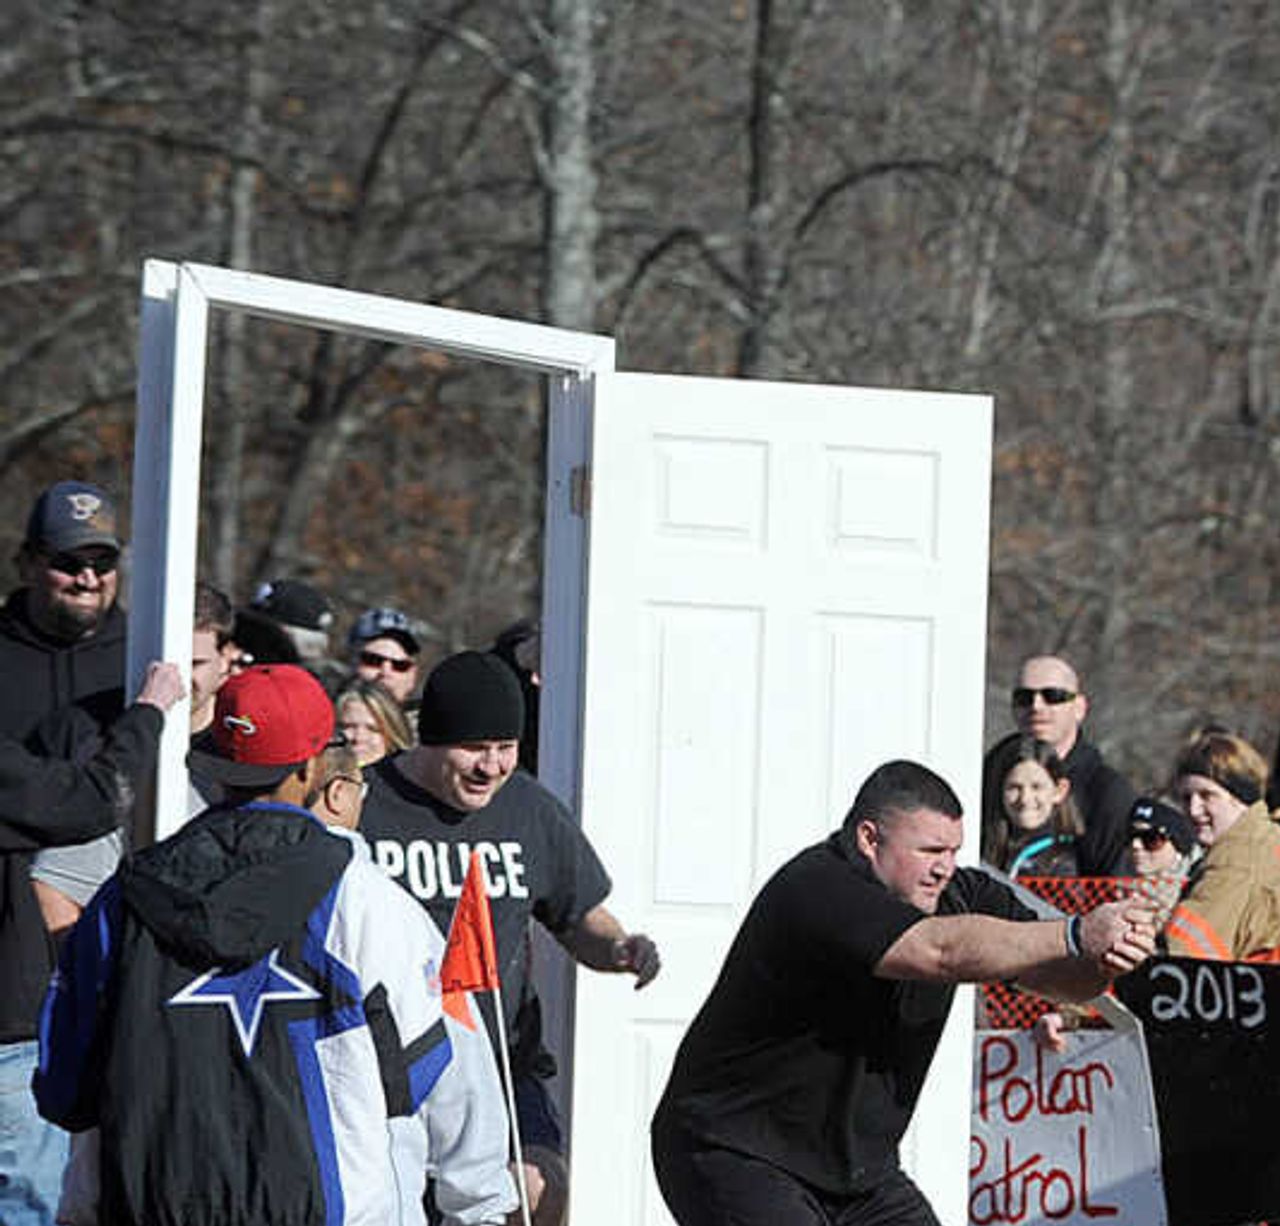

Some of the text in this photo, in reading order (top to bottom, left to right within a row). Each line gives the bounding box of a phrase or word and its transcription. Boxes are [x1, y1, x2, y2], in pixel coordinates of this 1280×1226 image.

[373, 839, 529, 899] POLICE
[1149, 963, 1267, 1028] 2013
[979, 1036, 1116, 1123] Polar
